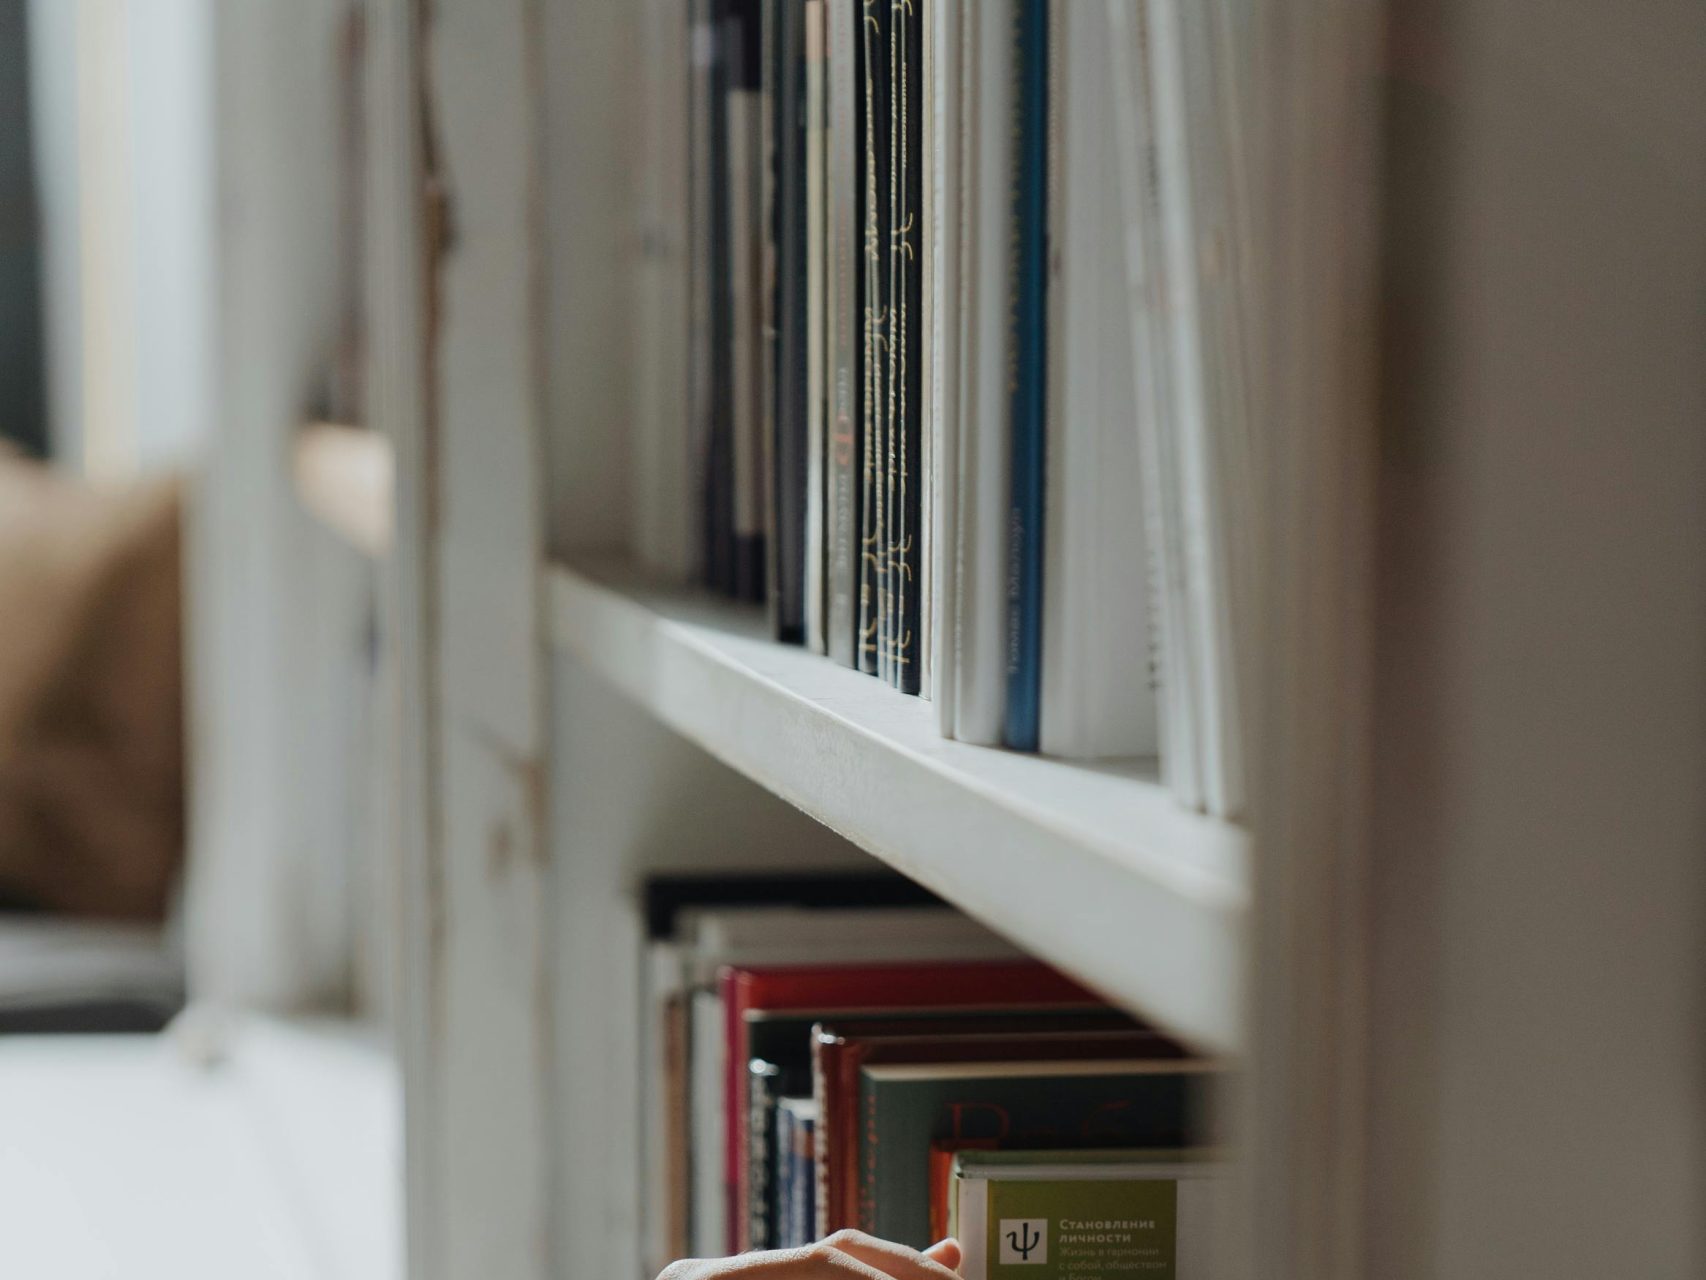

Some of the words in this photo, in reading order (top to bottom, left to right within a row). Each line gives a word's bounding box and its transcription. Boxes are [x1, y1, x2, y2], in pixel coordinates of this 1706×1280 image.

[1059, 1248, 1097, 1257] Жизнь
[1106, 1248, 1160, 1258] гармонии
[1105, 1259, 1168, 1271] обществом
